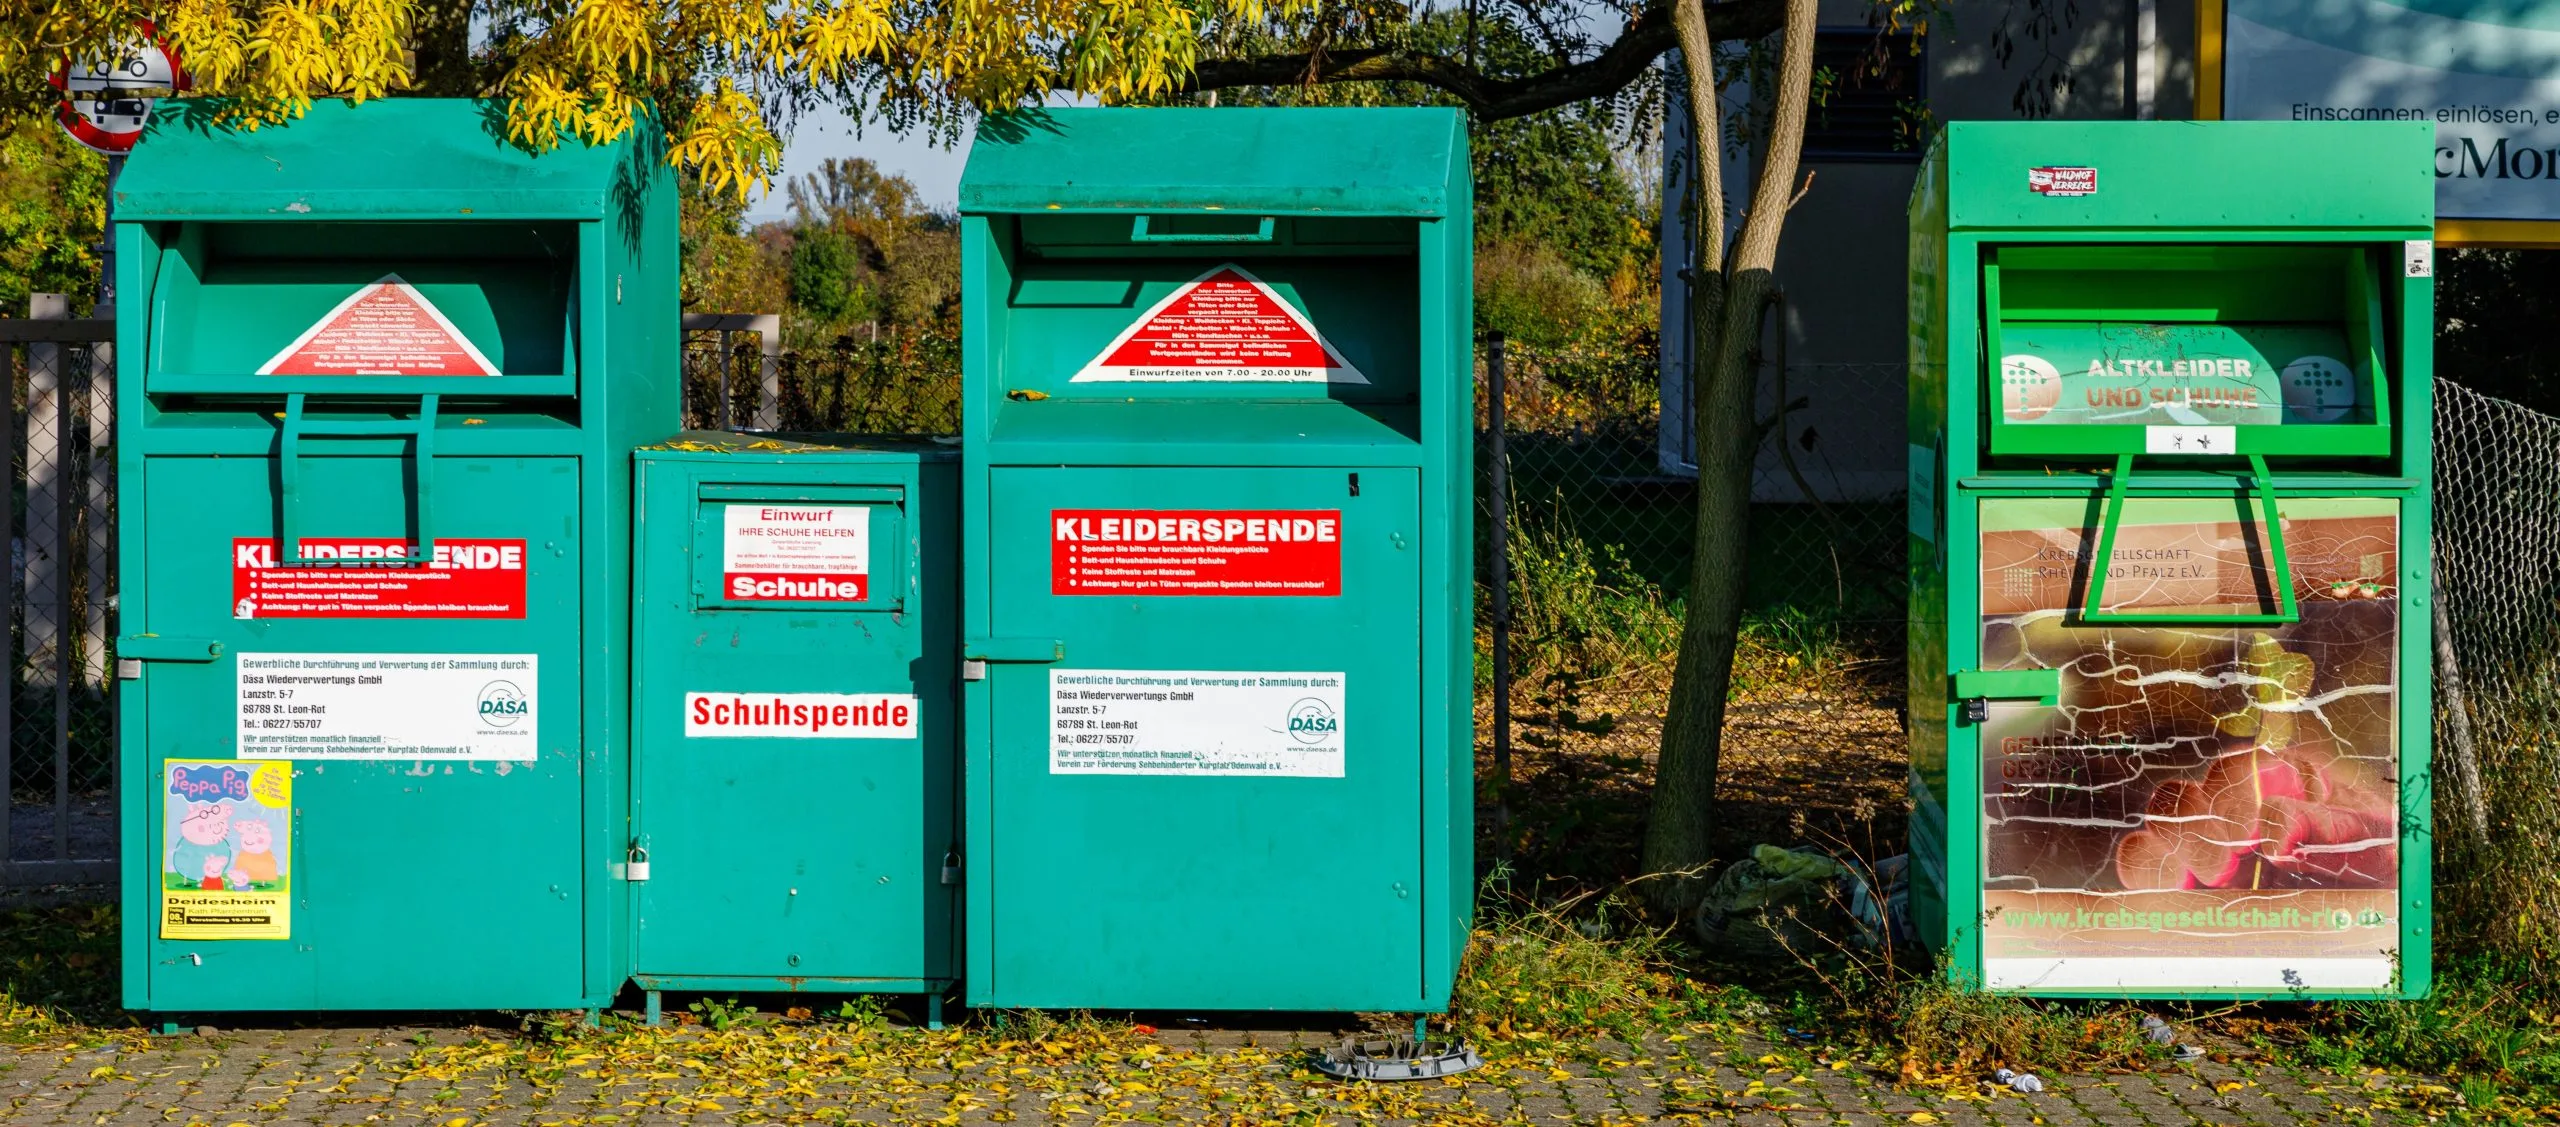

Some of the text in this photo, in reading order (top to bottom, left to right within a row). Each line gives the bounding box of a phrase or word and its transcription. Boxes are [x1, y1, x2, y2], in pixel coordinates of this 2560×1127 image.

[2436, 104, 2537, 127] einlösen,
[2087, 360, 2252, 378] ALTKLEIDER
[2088, 387, 2258, 409] UND SCHUHE
[761, 509, 832, 521] Einwurf
[767, 528, 810, 536] SCHUHE
[814, 529, 854, 537] HELFEN
[1056, 518, 1336, 541] KLEIDERSPENDE
[2039, 565, 2175, 578] RHEINLND-PFALZ
[733, 577, 858, 597] Schuhe
[1082, 580, 1120, 588] Achtung:
[243, 659, 300, 668] Gewerbliche
[303, 661, 359, 669] Durchführung
[379, 662, 428, 670] Verwertung
[431, 661, 445, 669] der
[449, 660, 498, 669] Sammlung
[501, 661, 529, 669] durch:
[243, 675, 382, 684] Däsa Wiederverwertungs GmbH
[1057, 676, 1113, 684] Gewerbliche
[1116, 677, 1172, 686] Durchführung
[1191, 678, 1239, 687] Verwertung
[1259, 678, 1308, 687] Sammlung
[1311, 678, 1338, 687] durch:
[243, 690, 293, 698] Lanzstr. 5-7
[1057, 691, 1193, 700] Däsa Wiederverwertungs GmbH
[243, 705, 325, 713] 68789 St. Leon-Rot
[480, 698, 528, 714] DÄSA
[1057, 706, 1106, 714] Lanzstr. 5-7
[694, 697, 908, 732] Schuhspende
[1058, 720, 1137, 729] 68789 St. Leon-Rot
[1290, 715, 1337, 732] DÄSA
[174, 769, 220, 798] Peppa
[224, 770, 246, 798] Pig
